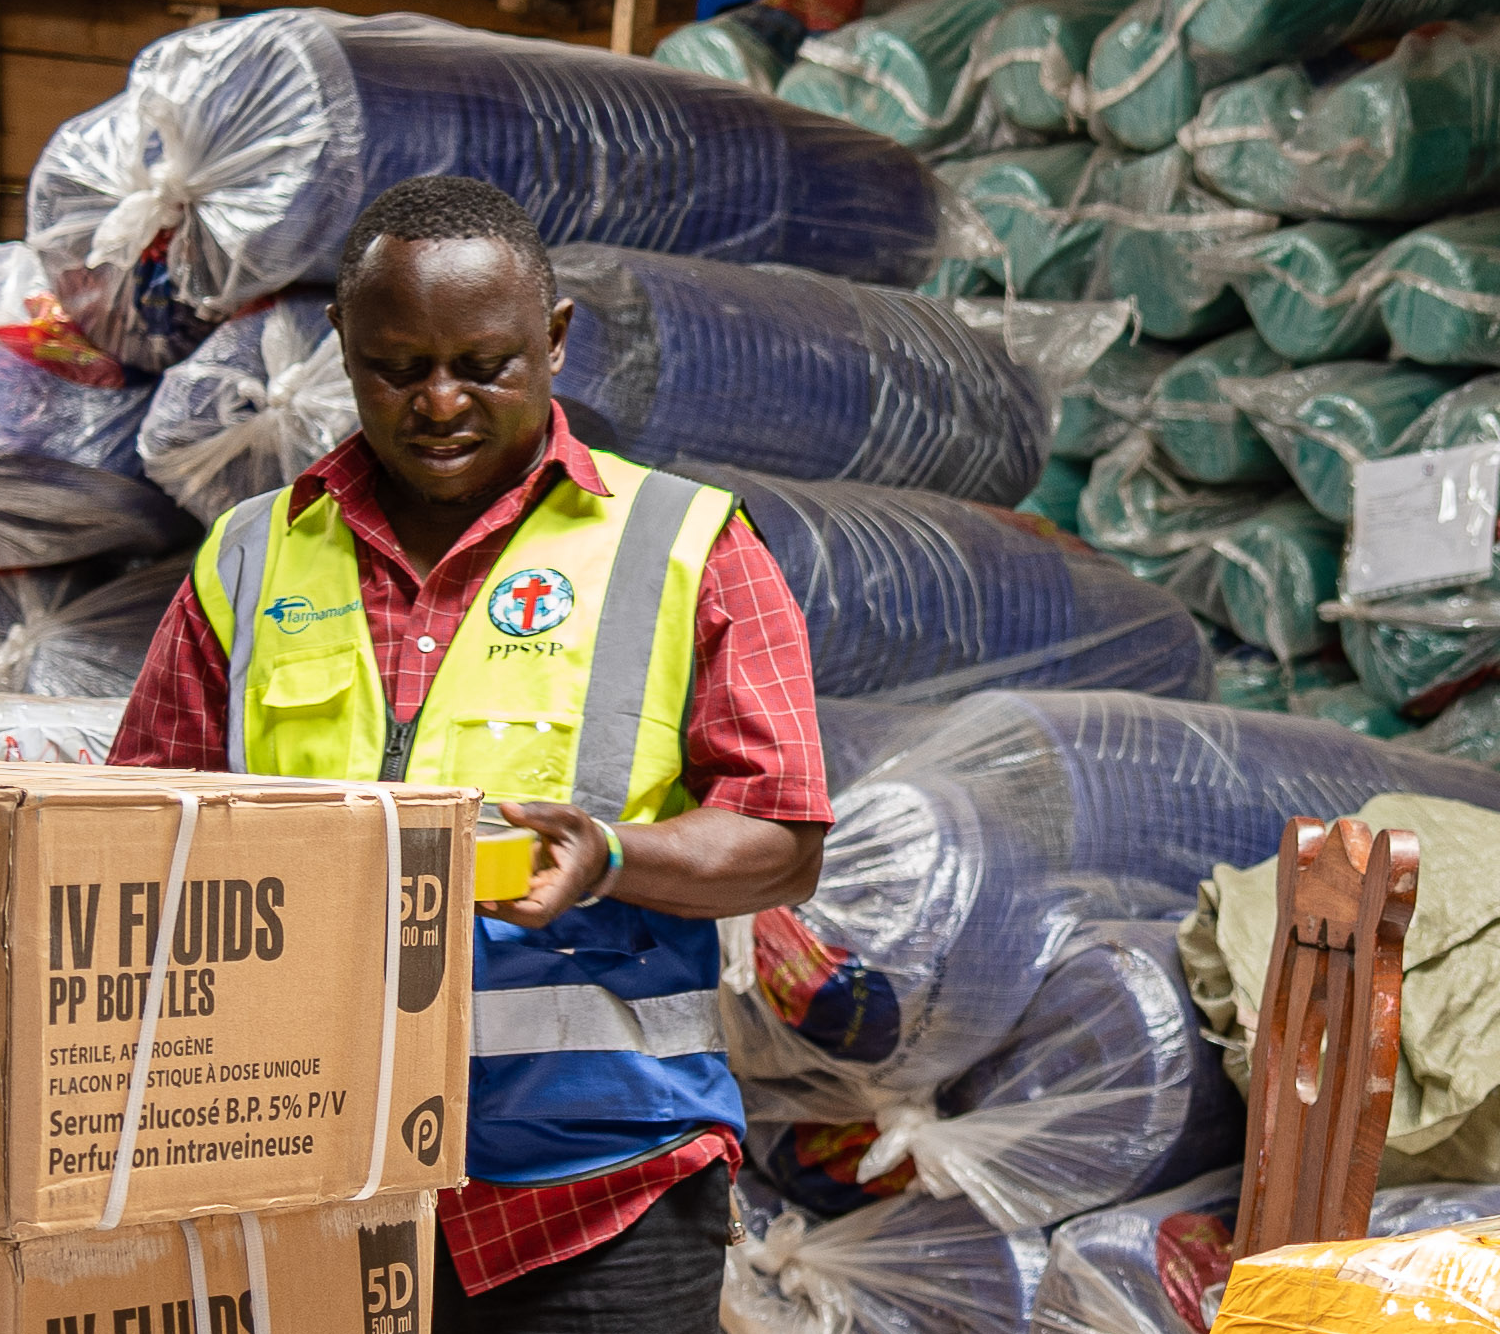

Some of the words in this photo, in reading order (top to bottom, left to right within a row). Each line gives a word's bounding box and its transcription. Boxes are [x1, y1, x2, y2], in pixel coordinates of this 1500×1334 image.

[486, 642, 563, 661] PPSSP
[49, 884, 101, 971] IV
[119, 877, 284, 967] FLUIDS
[49, 976, 86, 1025] PP
[50, 1045, 116, 1066] STÉRILE,
[50, 1075, 112, 1096] FLACON
[220, 1063, 260, 1083] DOSE
[264, 1058, 320, 1079] UNIQUE
[50, 1110, 124, 1137] Serum
[226, 1097, 262, 1124] B.P.
[268, 1094, 301, 1121] 5%
[308, 1090, 346, 1118] P/V
[166, 1133, 314, 1165] intraveineuse
[367, 1263, 414, 1314] 5D
